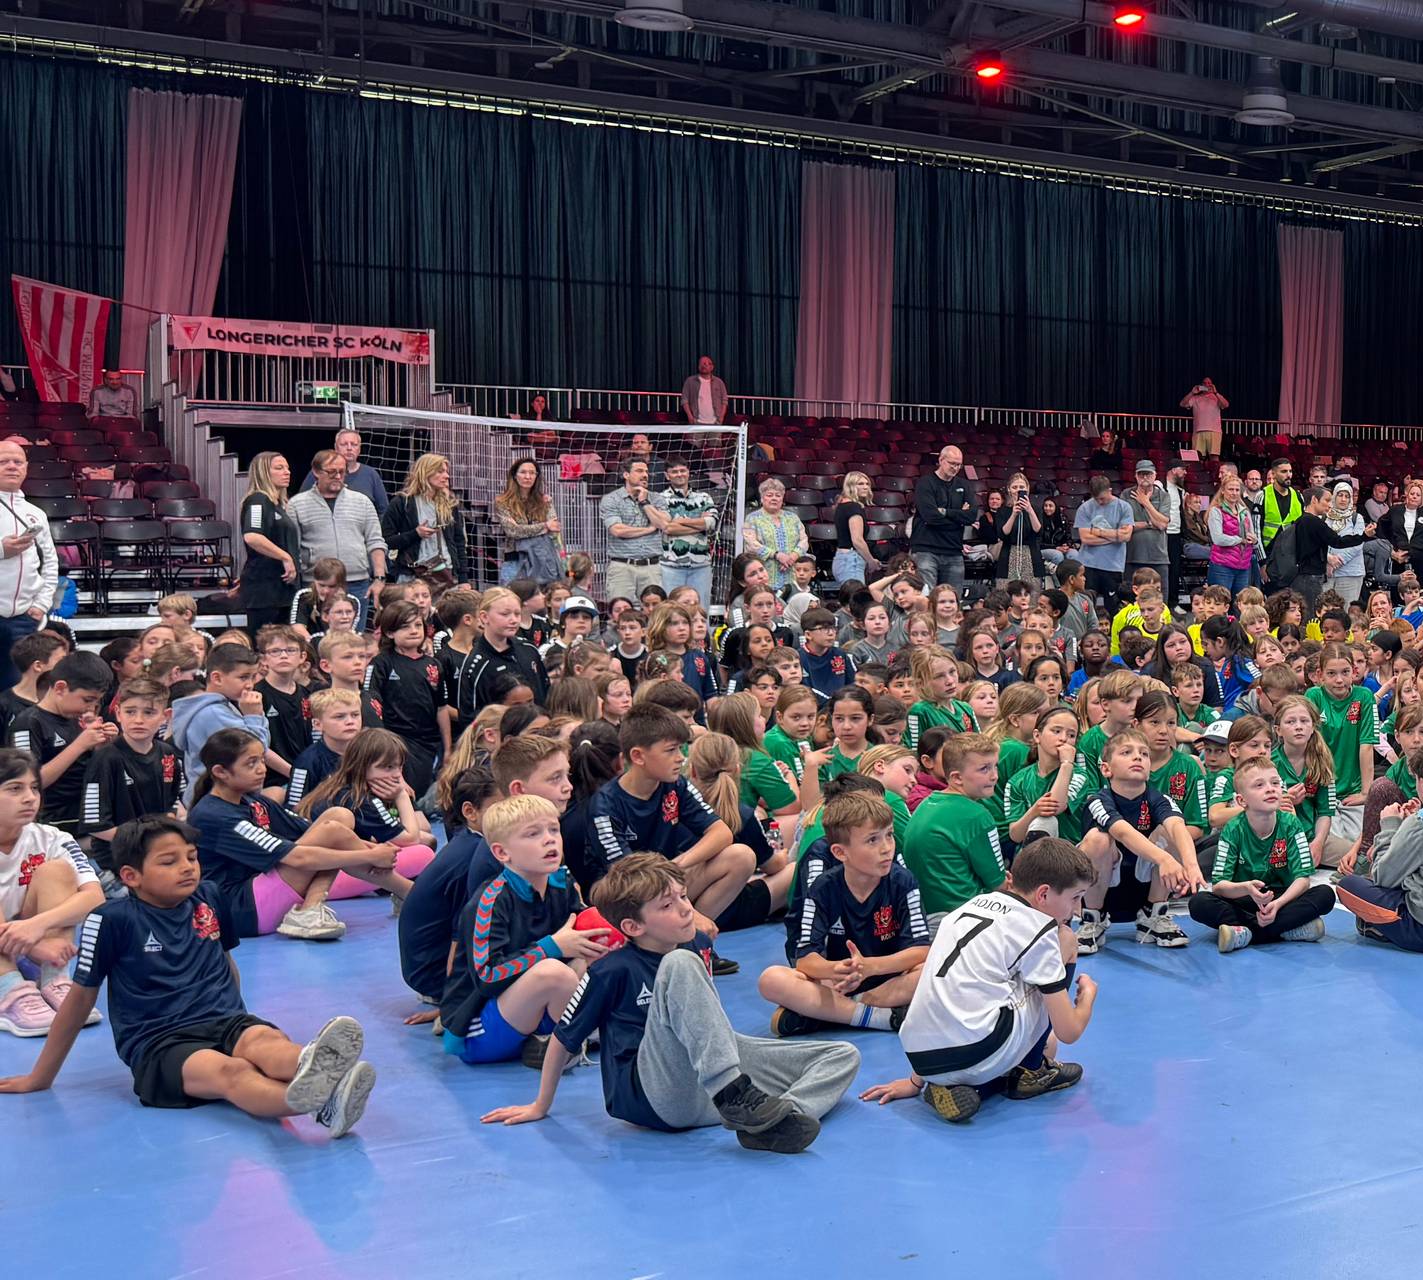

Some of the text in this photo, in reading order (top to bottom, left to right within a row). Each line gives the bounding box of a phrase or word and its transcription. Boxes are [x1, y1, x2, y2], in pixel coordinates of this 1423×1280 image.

[207, 327, 328, 349] LONGERICHER
[333, 336, 356, 349] SC
[360, 334, 403, 353] KÖLN
[936, 912, 994, 977] 7
